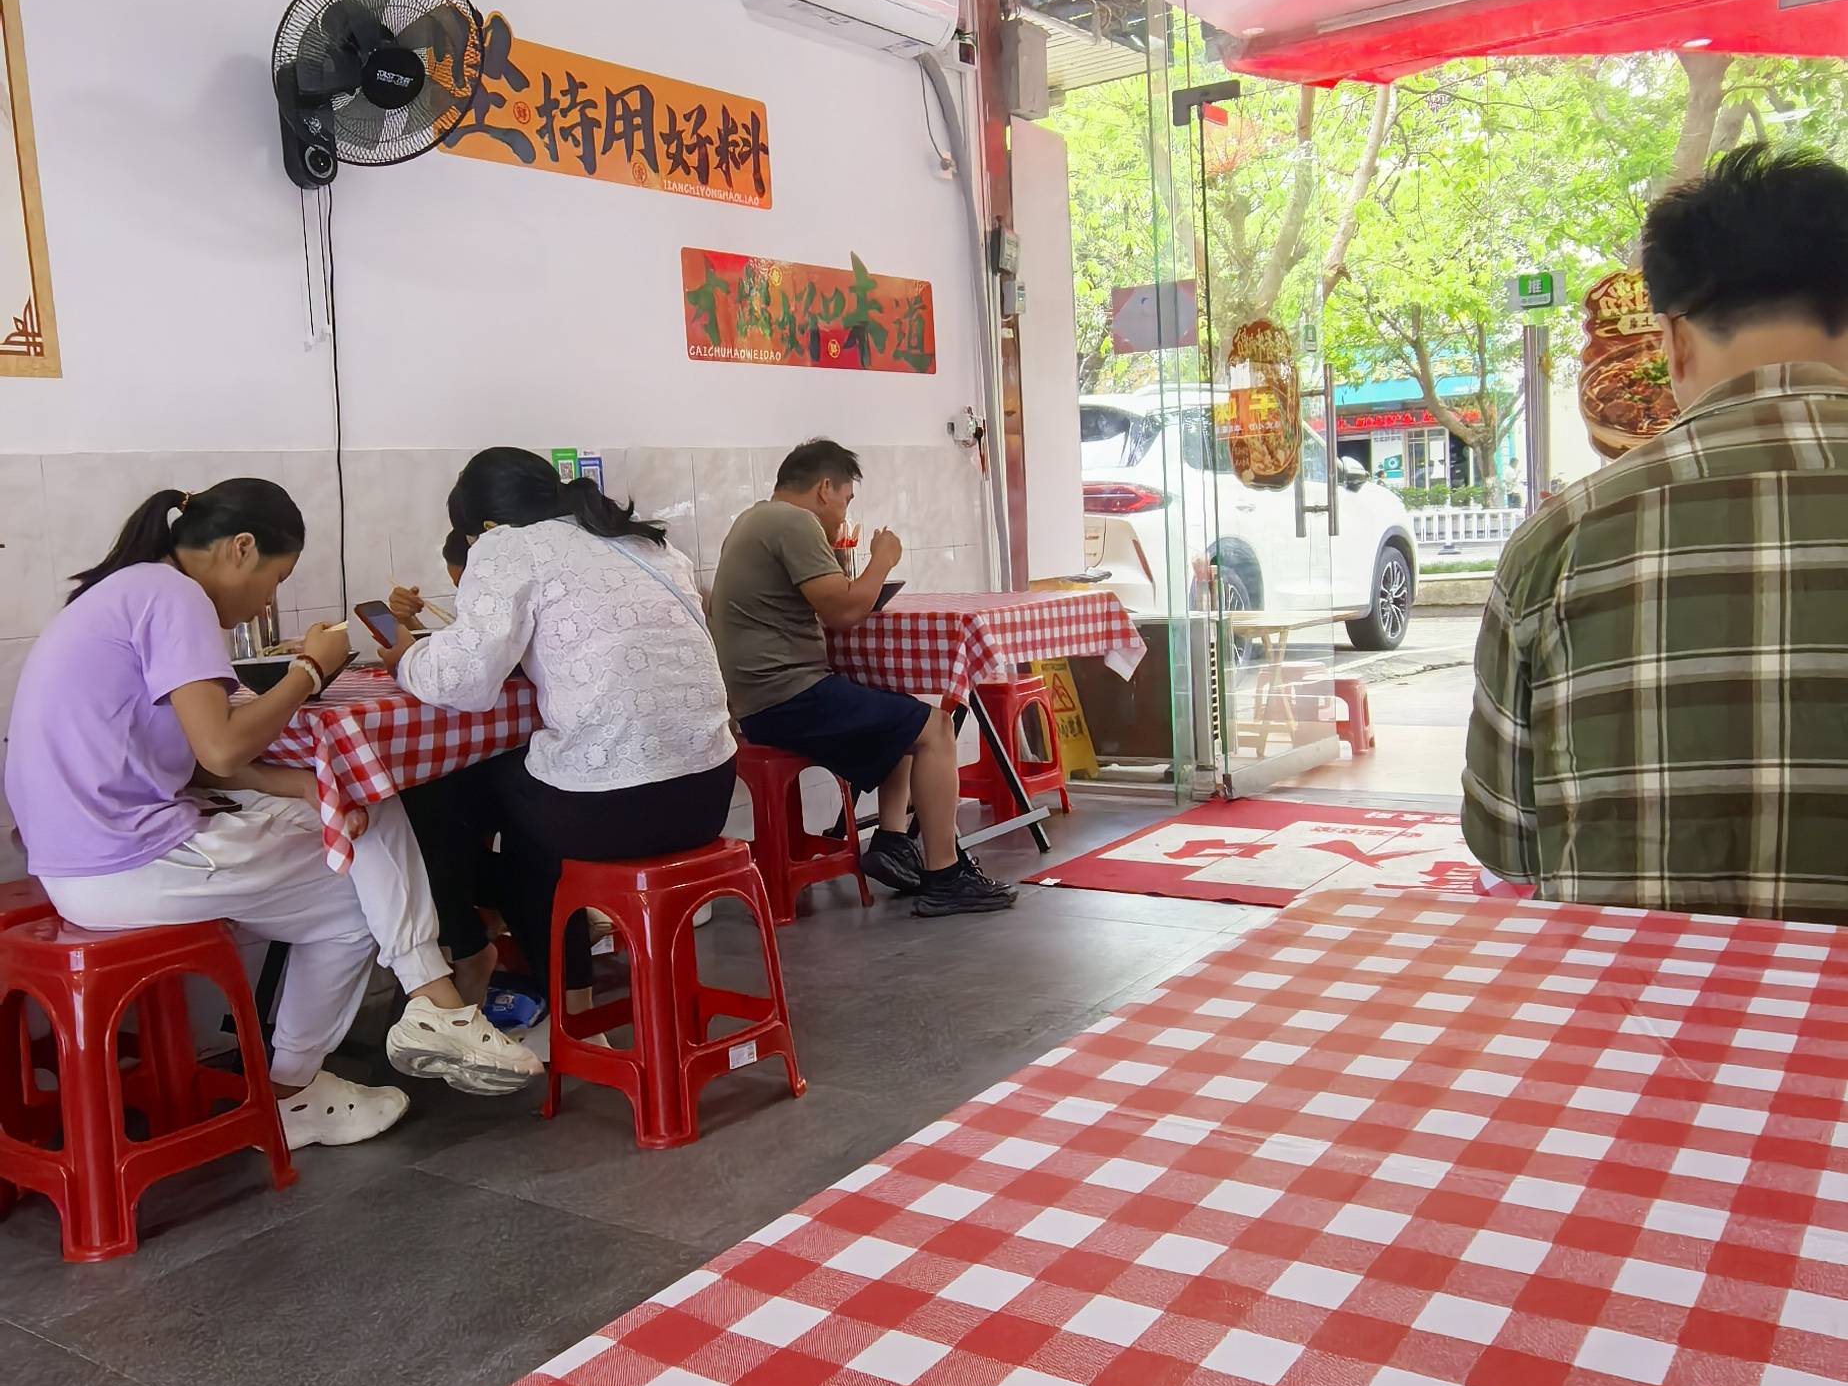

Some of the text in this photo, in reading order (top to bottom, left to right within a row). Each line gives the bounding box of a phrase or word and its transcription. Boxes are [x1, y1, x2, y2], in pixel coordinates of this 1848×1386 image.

[432, 7, 769, 198] 坚持用好料
